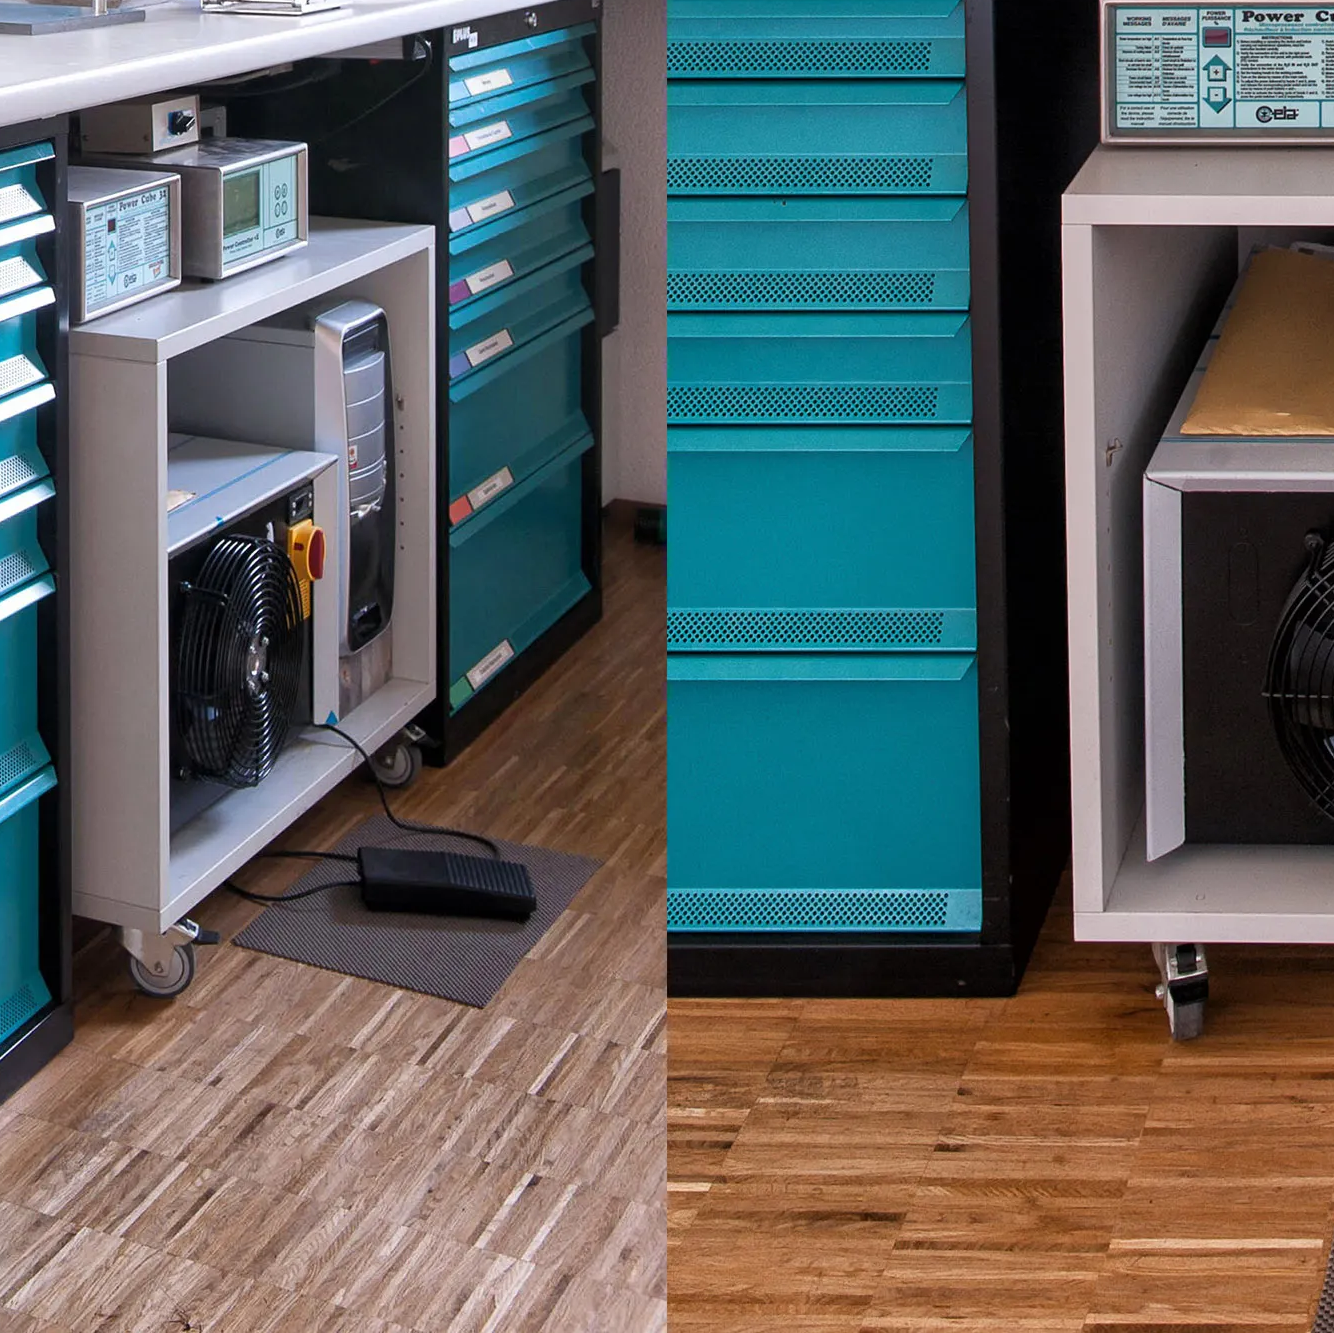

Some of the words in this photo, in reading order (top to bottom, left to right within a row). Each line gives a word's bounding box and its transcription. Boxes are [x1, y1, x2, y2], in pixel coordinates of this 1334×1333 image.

[1242, 10, 1305, 23] Power
[118, 199, 139, 212] Power
[141, 193, 157, 205] Cube
